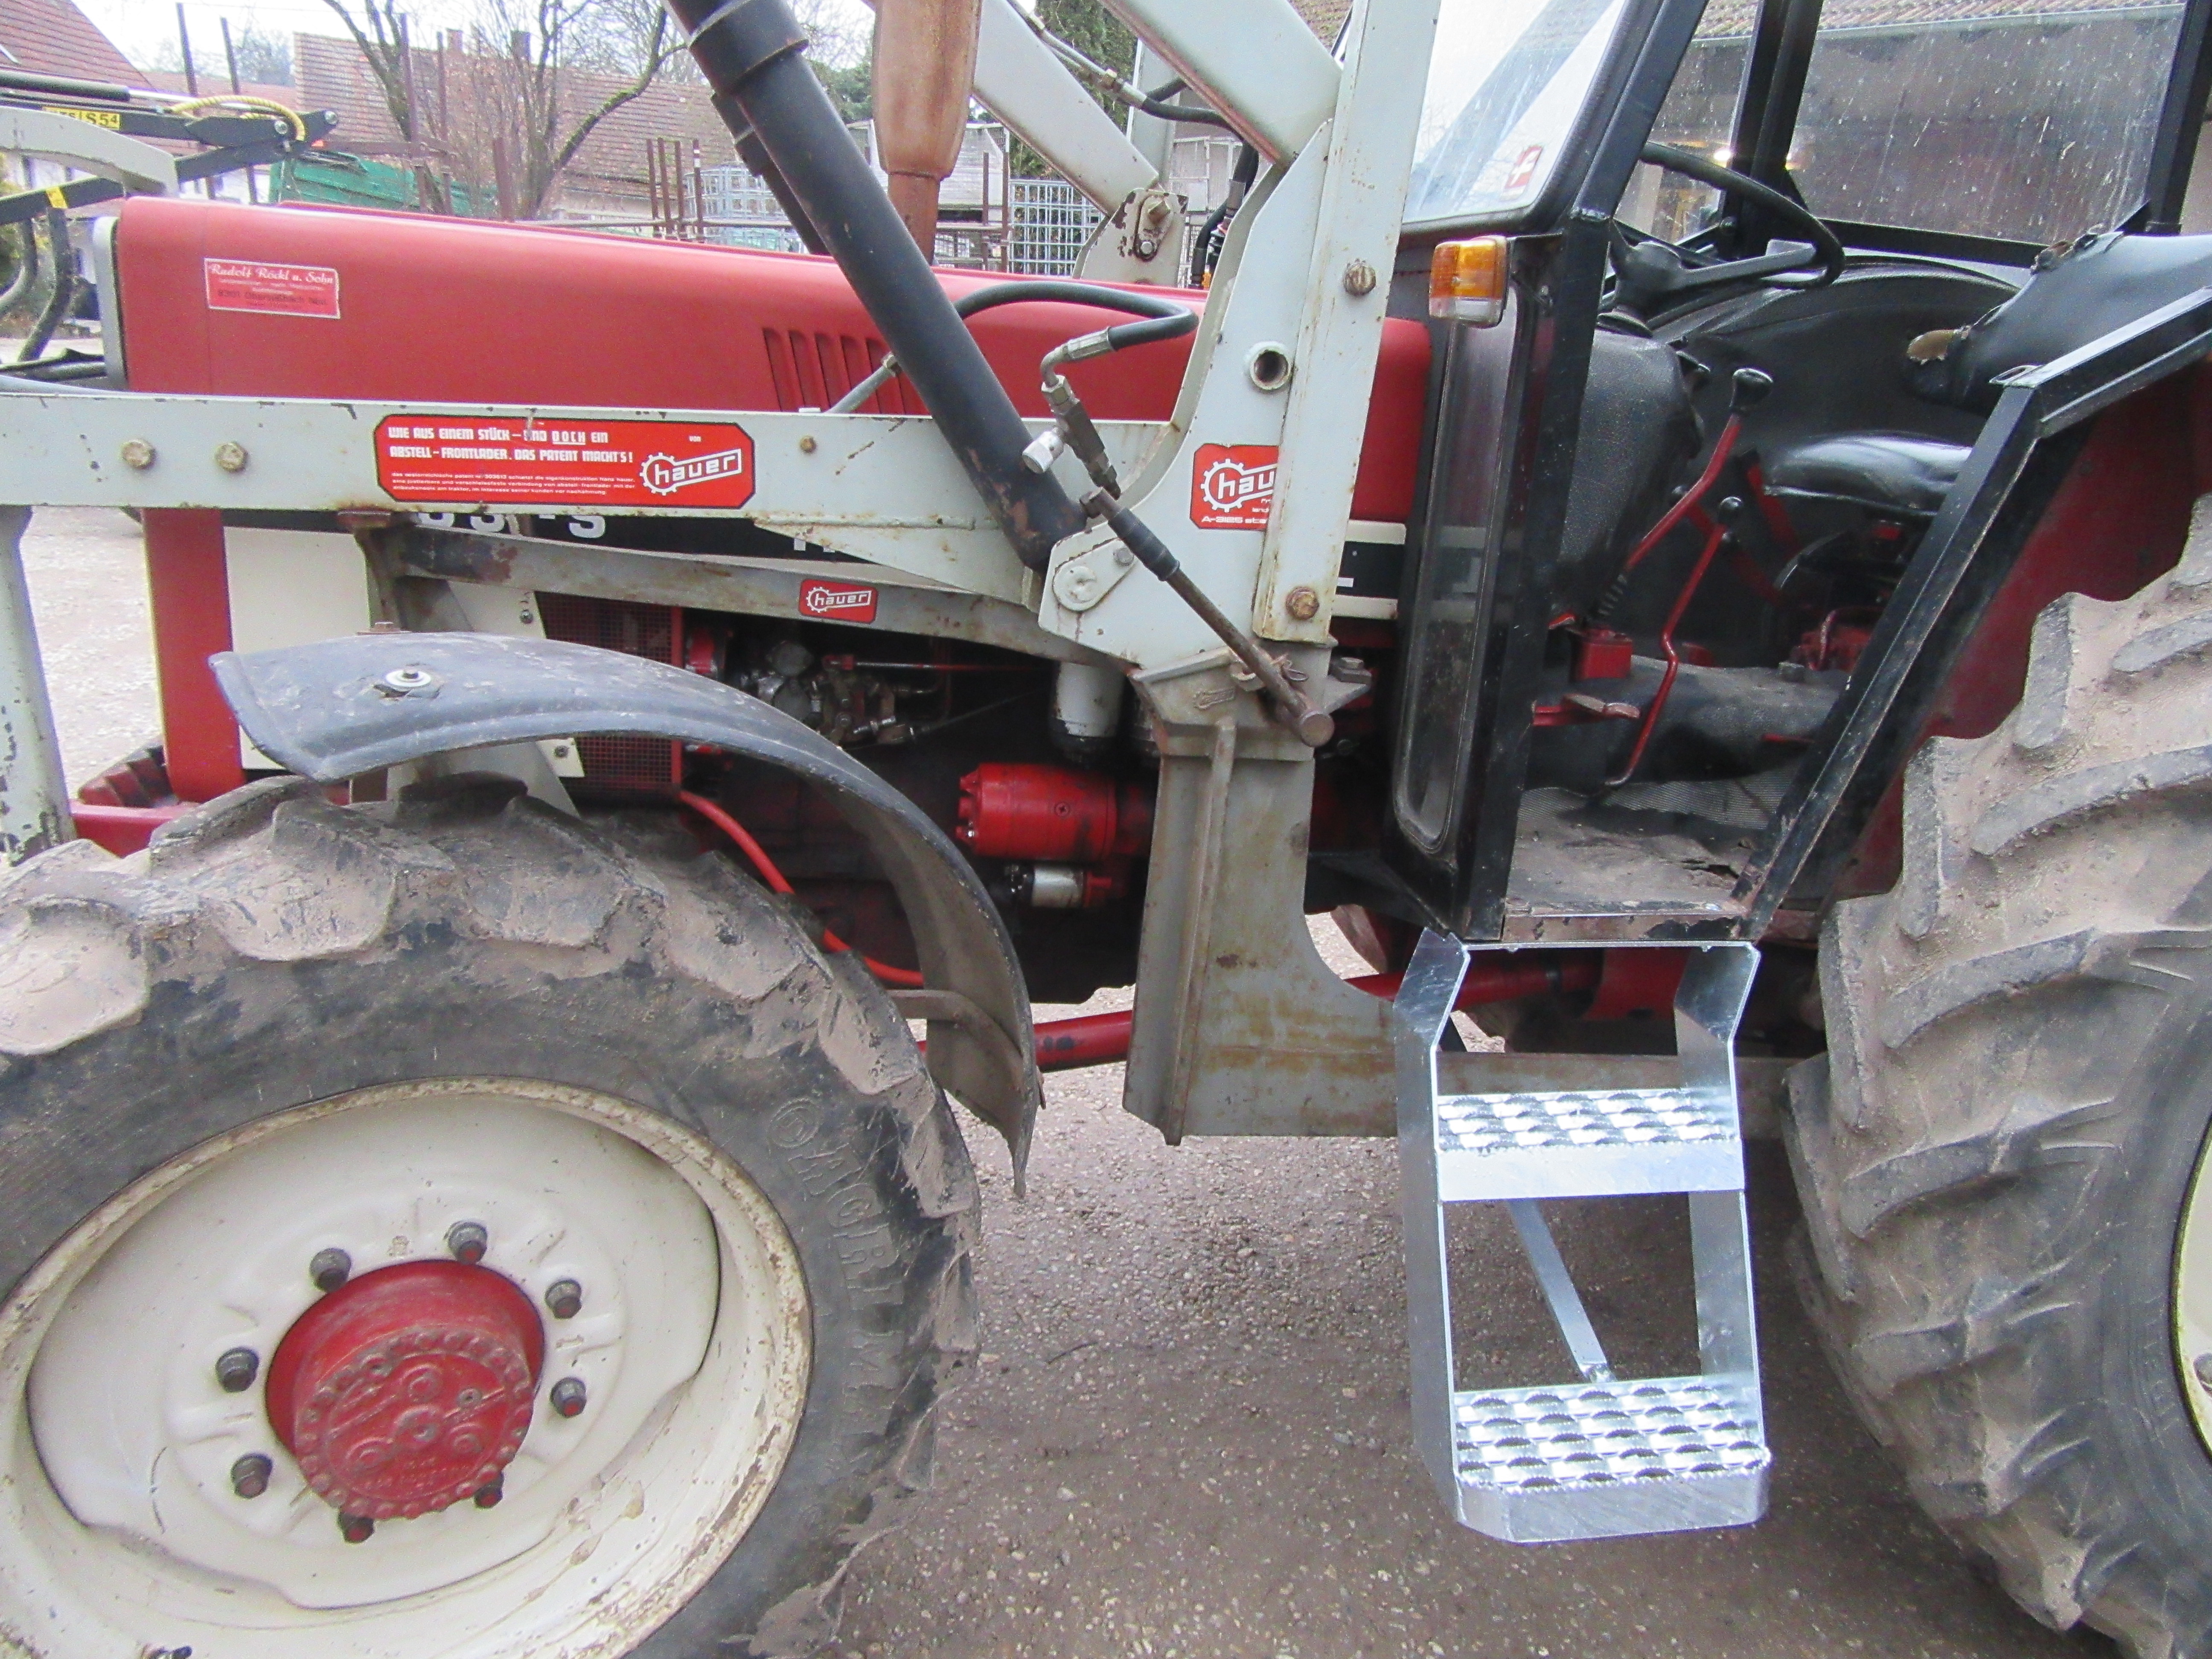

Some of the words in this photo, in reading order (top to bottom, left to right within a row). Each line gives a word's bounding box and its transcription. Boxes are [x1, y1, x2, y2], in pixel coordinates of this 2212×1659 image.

[209, 264, 251, 277] Rudolf
[306, 272, 333, 285] Sohn
[388, 427, 410, 438] WIE
[413, 428, 434, 439] AUS
[439, 428, 474, 439] EINEM
[478, 427, 510, 440] STÜCK
[552, 431, 585, 442] DOCH
[591, 431, 608, 442] EIN
[514, 449, 535, 460] DAS
[539, 450, 578, 461] PATENT
[655, 455, 736, 485] hauer
[1218, 471, 1275, 499] hau
[814, 593, 867, 606] hauer
